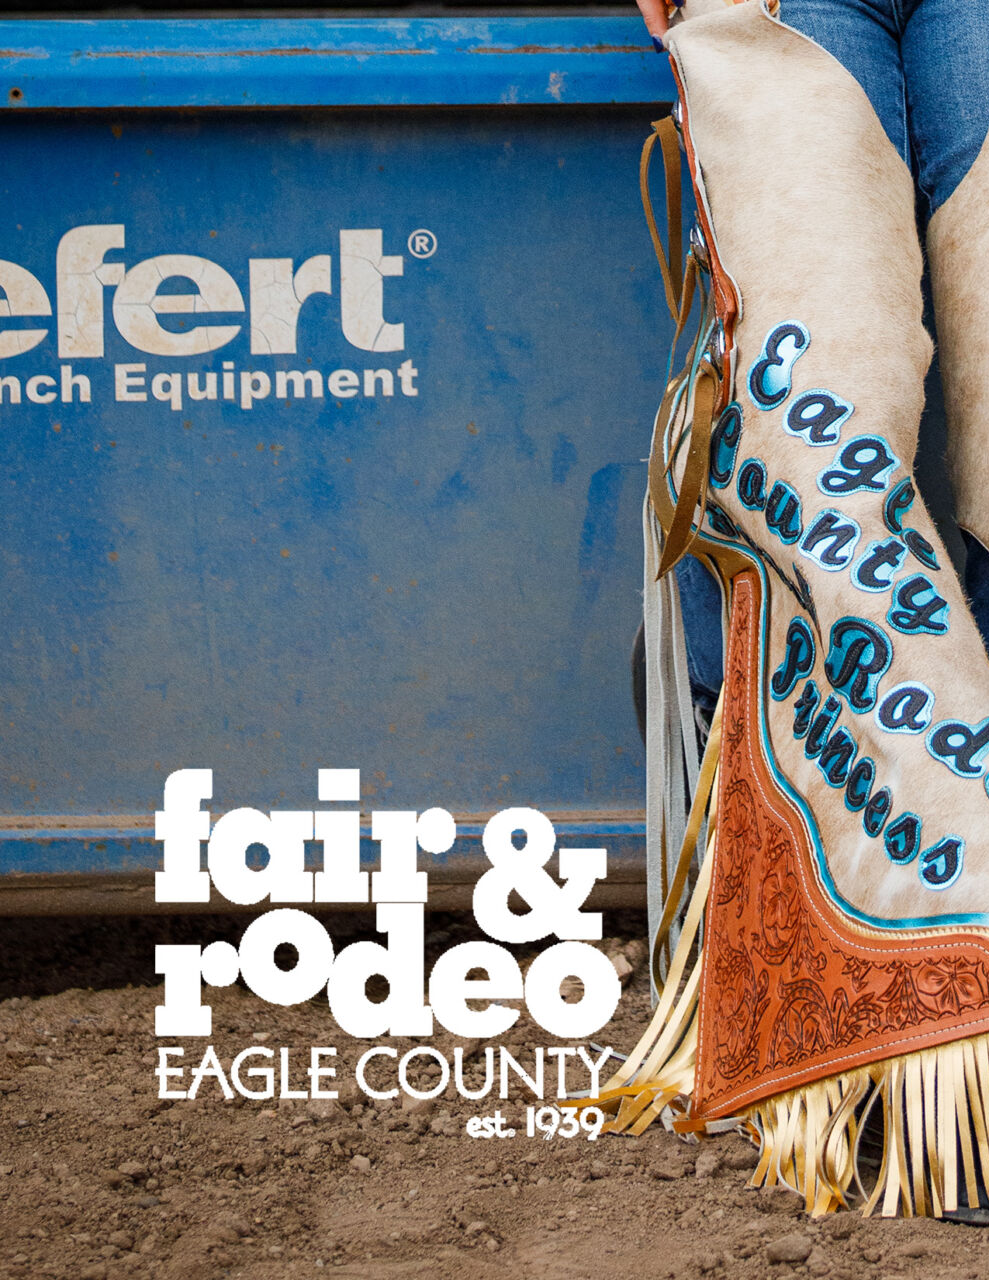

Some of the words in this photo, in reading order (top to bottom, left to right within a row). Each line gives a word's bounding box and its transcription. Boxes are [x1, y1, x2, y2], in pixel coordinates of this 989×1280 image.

[114, 359, 419, 412] Equipment
[710, 401, 951, 637] County
[770, 615, 967, 892] Princess
